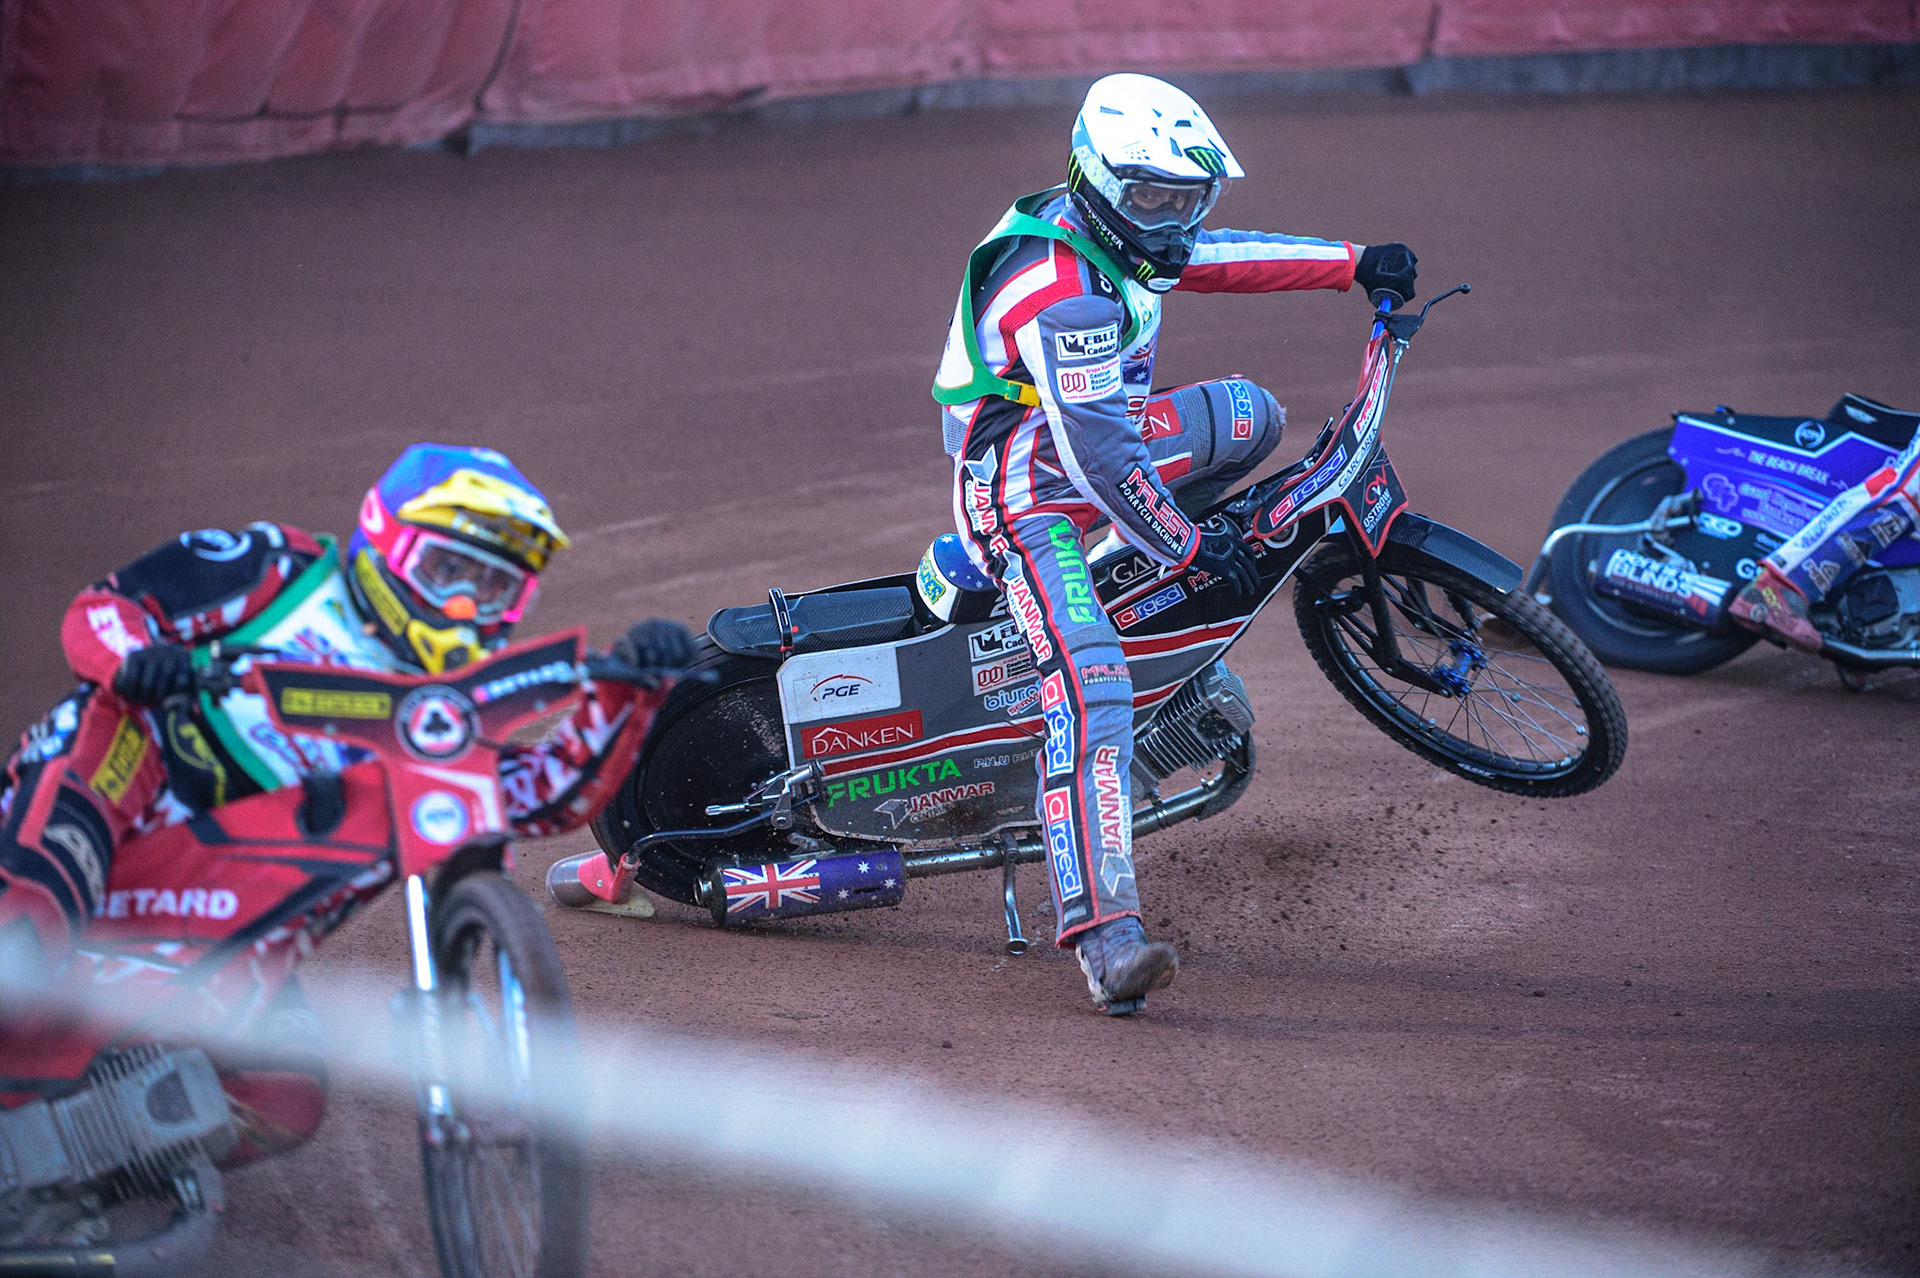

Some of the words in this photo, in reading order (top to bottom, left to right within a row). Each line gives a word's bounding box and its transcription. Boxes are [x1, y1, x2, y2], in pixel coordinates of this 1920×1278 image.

[1082, 200, 1124, 250] MONSTER
[1120, 482, 1152, 524] POKRYCIA
[1151, 521, 1184, 554] DACHOWE
[1121, 584, 1183, 624] arged
[1612, 561, 1693, 598] BLINDS
[1011, 580, 1051, 659] JANMAR
[822, 683, 860, 700] PGE
[811, 723, 914, 756] DANKEN
[1044, 680, 1075, 771] arged
[827, 758, 962, 809] FRUKTA
[909, 782, 994, 814] JANMAR
[1095, 747, 1123, 854] JANMAR
[1049, 796, 1083, 894] arged
